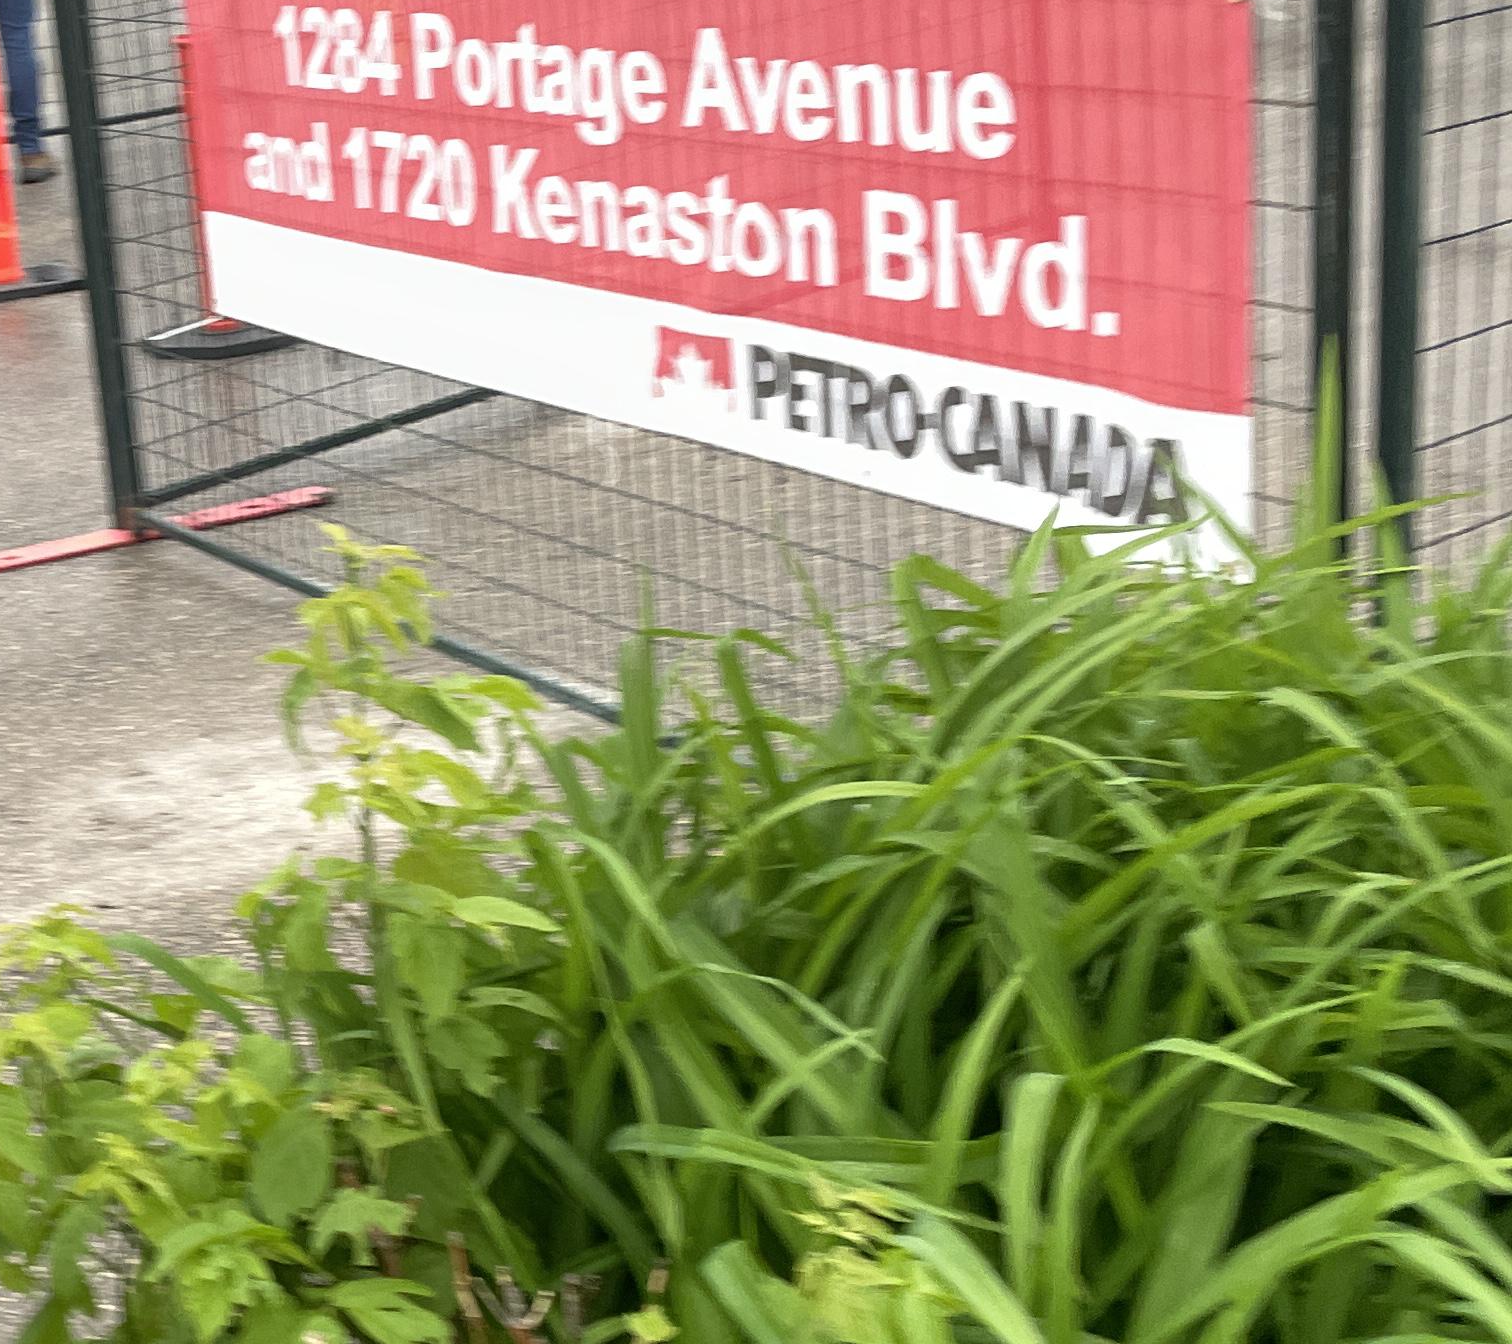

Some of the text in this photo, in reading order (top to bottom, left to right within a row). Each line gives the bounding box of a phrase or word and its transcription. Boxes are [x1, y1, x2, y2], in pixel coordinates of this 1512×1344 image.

[275, 6, 1014, 159] 1284 Portage Avenue
[245, 123, 1118, 336] and 1720 Kenaston Blvd.
[748, 345, 1190, 524] PETRO-CANADA
